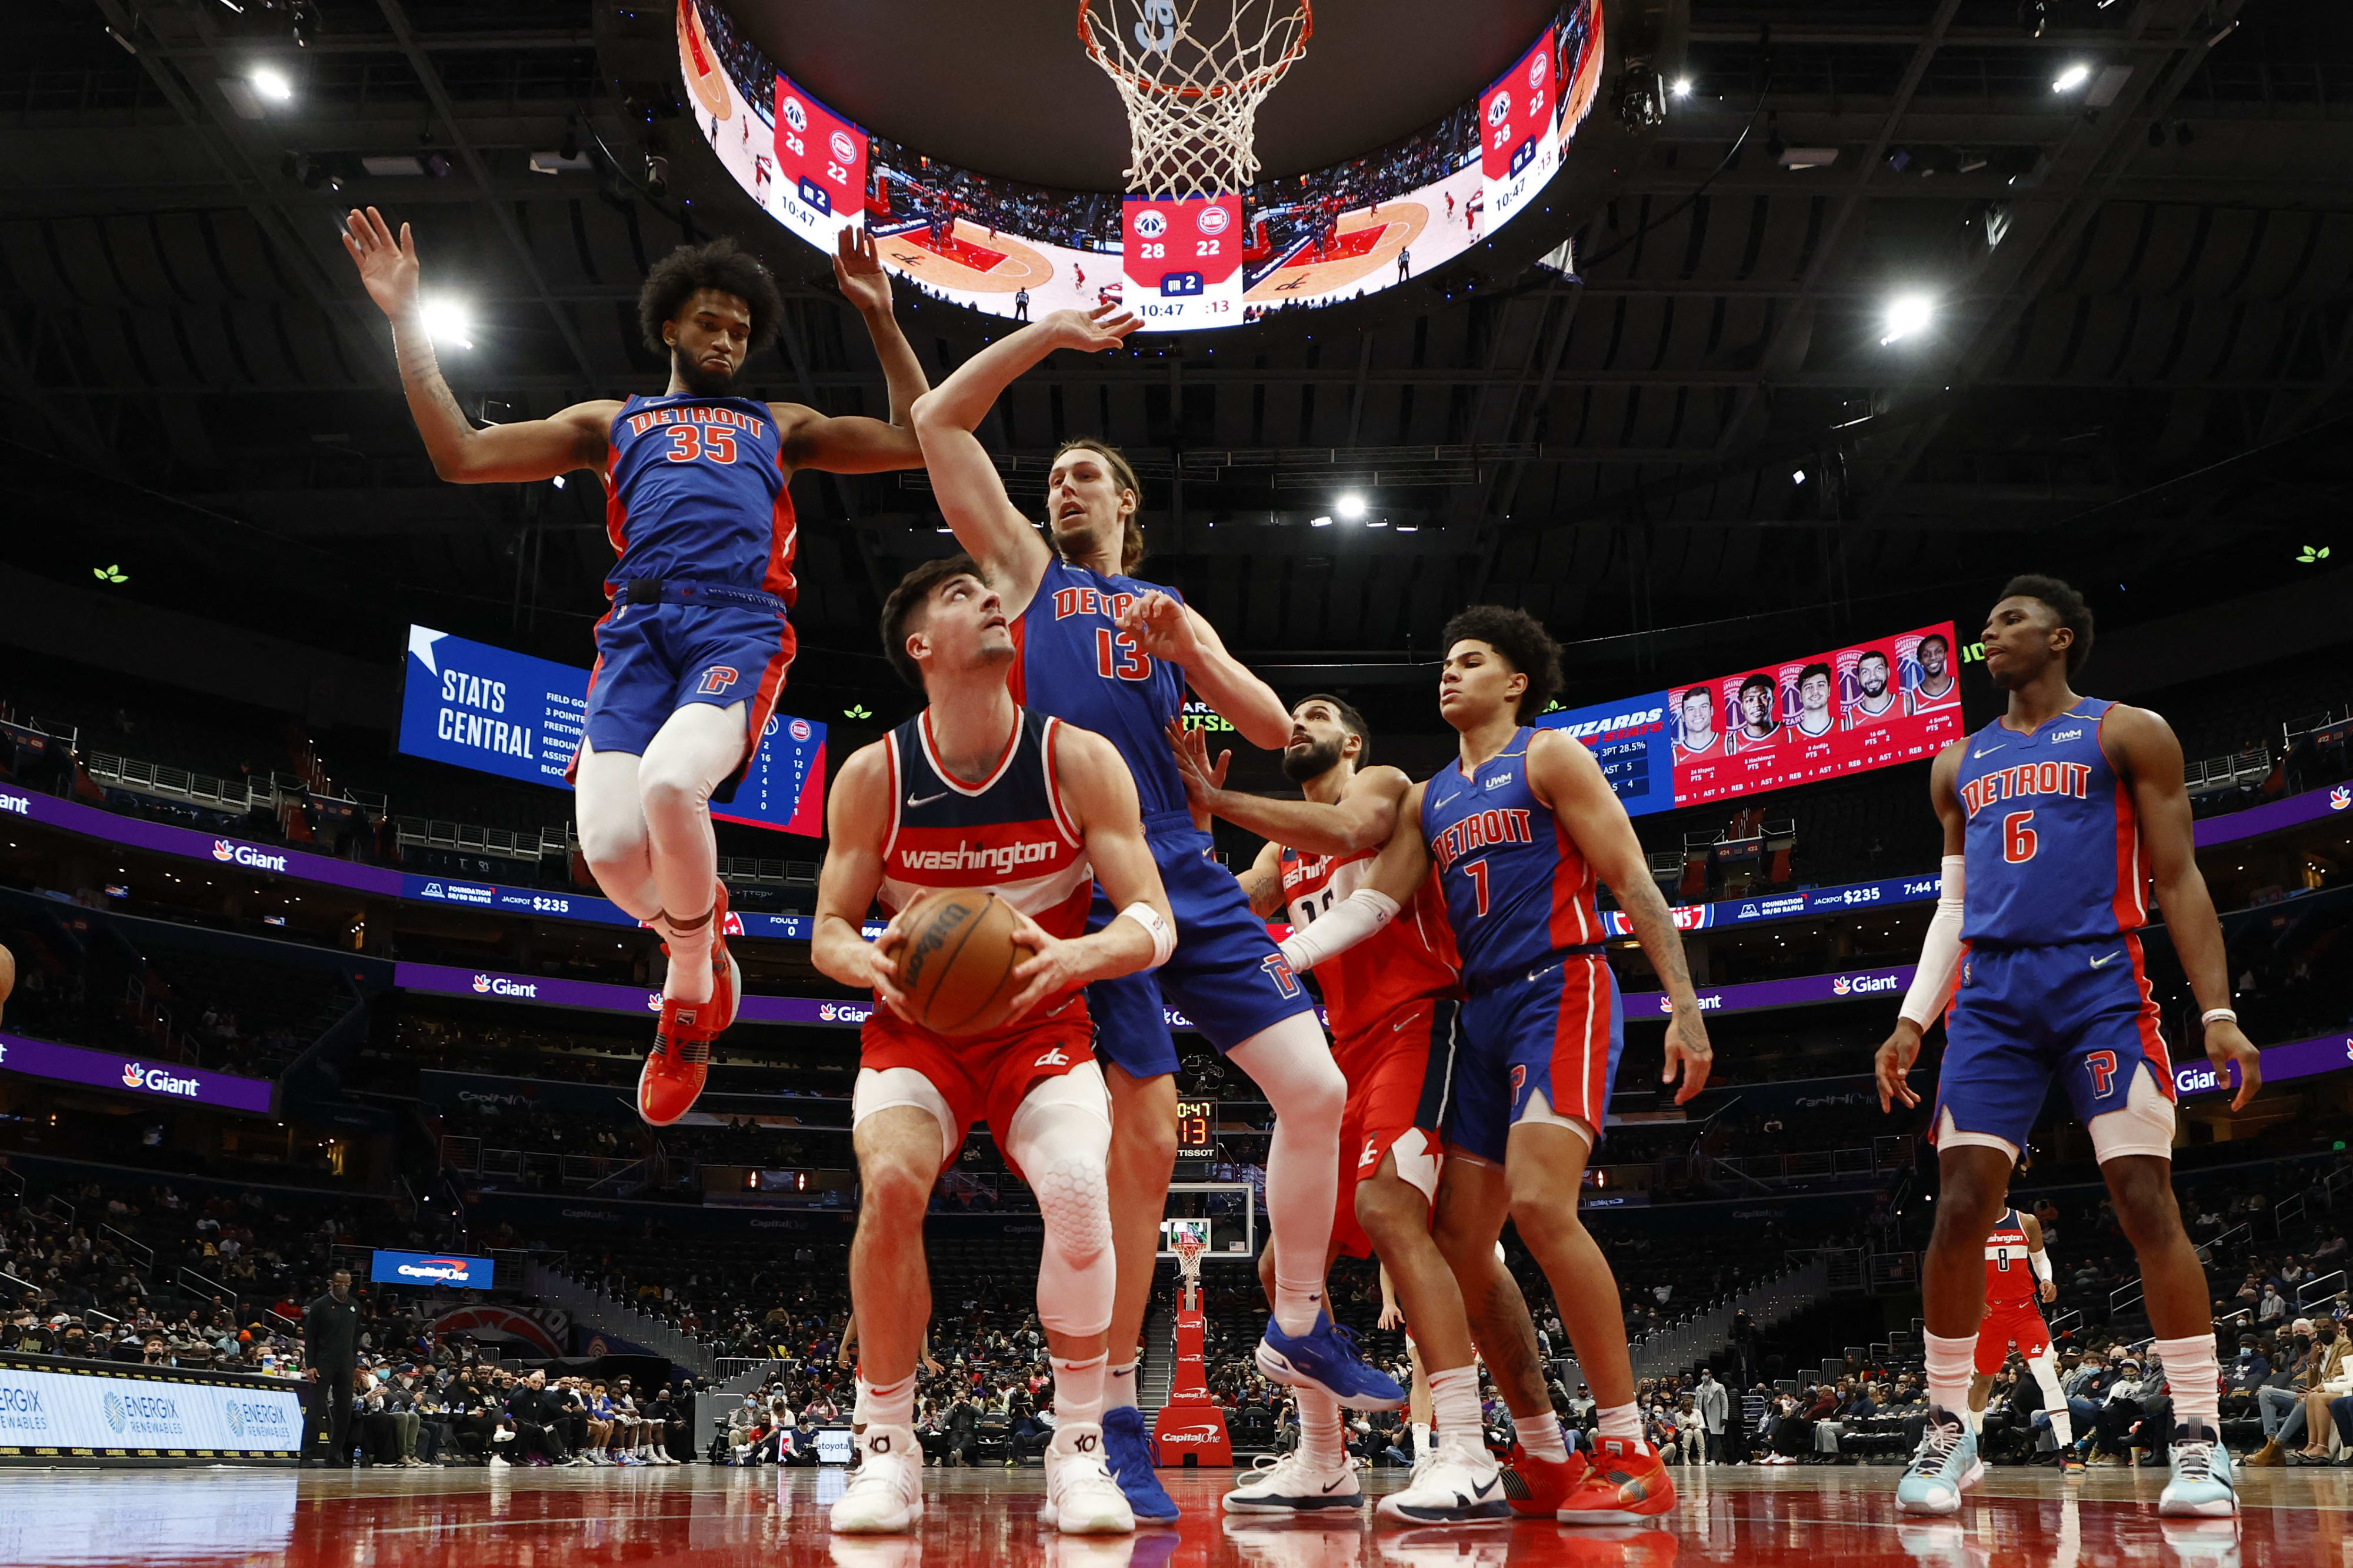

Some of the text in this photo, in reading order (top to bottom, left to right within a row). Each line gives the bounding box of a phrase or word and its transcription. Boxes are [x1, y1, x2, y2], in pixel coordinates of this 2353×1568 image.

[1529, 89, 1544, 118] 22
[785, 131, 804, 156] 28
[1494, 123, 1511, 150] 28
[1524, 141, 1531, 159] 2
[827, 161, 847, 185] 22
[816, 189, 826, 207] 2
[1496, 177, 1525, 212] 10:47
[782, 196, 815, 227] 10:47
[1141, 239, 1220, 258] 28 22
[1185, 275, 1195, 289] 2
[1140, 301, 1229, 316] 10:47 :13
[627, 406, 764, 439] DETROIT
[665, 425, 737, 465] 35
[1052, 587, 1139, 620] DETR
[1096, 627, 1151, 681] 13
[442, 669, 506, 713] STATS
[546, 692, 570, 705] FIELD
[545, 708, 551, 716] 3
[1552, 708, 1663, 738] WIZARDS
[1602, 721, 1664, 743] STATS
[1926, 724, 1938, 732] PTS
[438, 708, 534, 759] CENTRAL
[1865, 738, 1877, 746] PTS
[2052, 729, 2082, 742] UWM
[1602, 746, 1617, 757] 3PT
[761, 753, 803, 769] 16 12
[1604, 762, 1632, 775] AST 5
[1704, 789, 1715, 797] AST
[1731, 783, 1744, 792] REB
[1761, 778, 1772, 786] AST
[1789, 772, 1802, 780] REB
[1819, 765, 1832, 774] AST
[1848, 759, 1861, 768] REB
[1879, 753, 1892, 761] AST
[1909, 746, 1922, 755] REB
[1941, 739, 1954, 748] AST
[1747, 763, 1759, 771] PTS
[1485, 772, 1512, 789] UWM
[1628, 780, 1634, 788] 4
[1690, 774, 1702, 783] PTS
[1961, 761, 2092, 819] DETROIT
[761, 802, 798, 816] 0 1
[1431, 807, 1532, 874] DETROIT
[2003, 809, 2038, 864] 6
[235, 845, 288, 872] Giant
[901, 839, 1056, 875] washington
[448, 885, 492, 897] FOUNDATION
[1464, 859, 1489, 918] 7
[1814, 888, 1880, 905] JACKPOT $235
[1904, 883, 1931, 895] 7:44
[468, 895, 492, 904] RAFFLE
[502, 896, 568, 913] JACKPOT $235
[1762, 898, 1803, 908] FOUNDATION
[1782, 904, 1804, 913] RAFFLE
[770, 916, 799, 925] FOULS
[788, 926, 795, 936] 0
[492, 978, 538, 998] Giant
[1852, 975, 1898, 993] Giant
[1034, 1047, 1069, 1067] dc
[146, 1069, 200, 1097] Giant
[2177, 1069, 2230, 1092] Gian
[1182, 1119, 1206, 1145] 13
[1178, 1149, 1214, 1157] TISSOT
[1998, 1247, 2009, 1272] 8
[2031, 1344, 2042, 1354] dc
[124, 1396, 179, 1419] ENERGIX
[243, 1403, 286, 1424] ENERGIX
[130, 1422, 183, 1434] RENEWABLES
[248, 1426, 290, 1438] RENEWABLES
